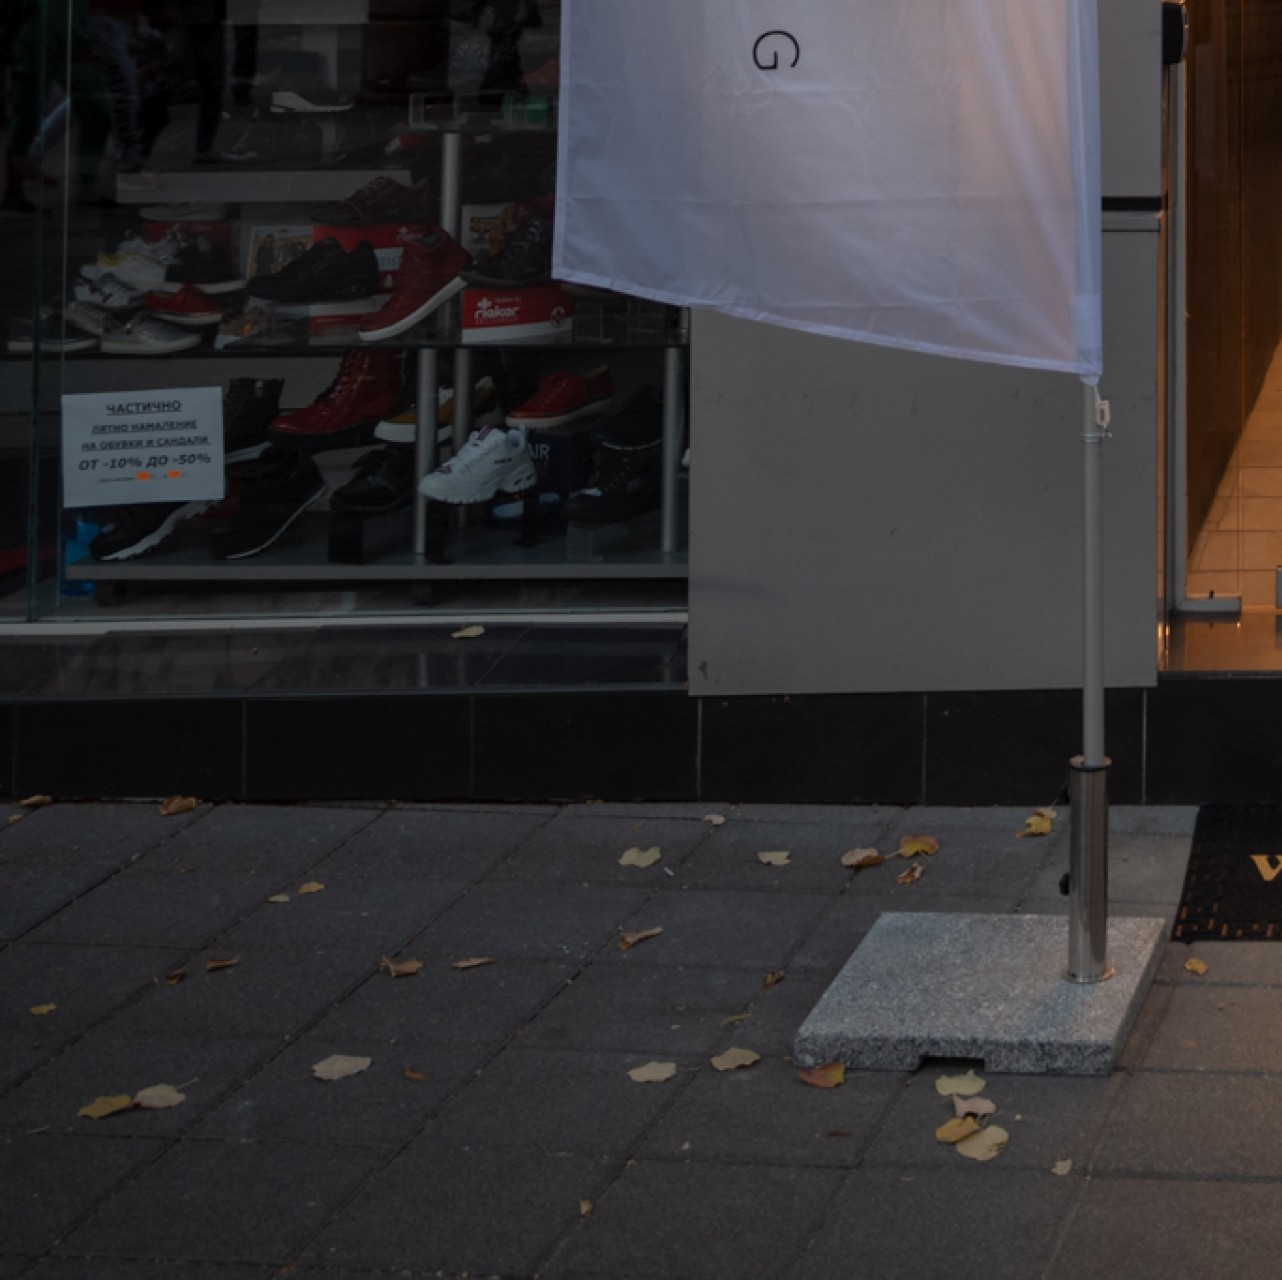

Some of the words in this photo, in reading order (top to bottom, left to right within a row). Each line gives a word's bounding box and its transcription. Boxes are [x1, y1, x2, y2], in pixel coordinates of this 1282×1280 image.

[106, 400, 182, 416] ЧАСТИЧНО
[131, 419, 198, 433] НАМАЛЕНИЕ
[99, 439, 143, 450] ОБУВКИ
[157, 435, 209, 447] САНДАЛИ
[78, 459, 99, 471] ОТ
[172, 452, 212, 466] -50%
